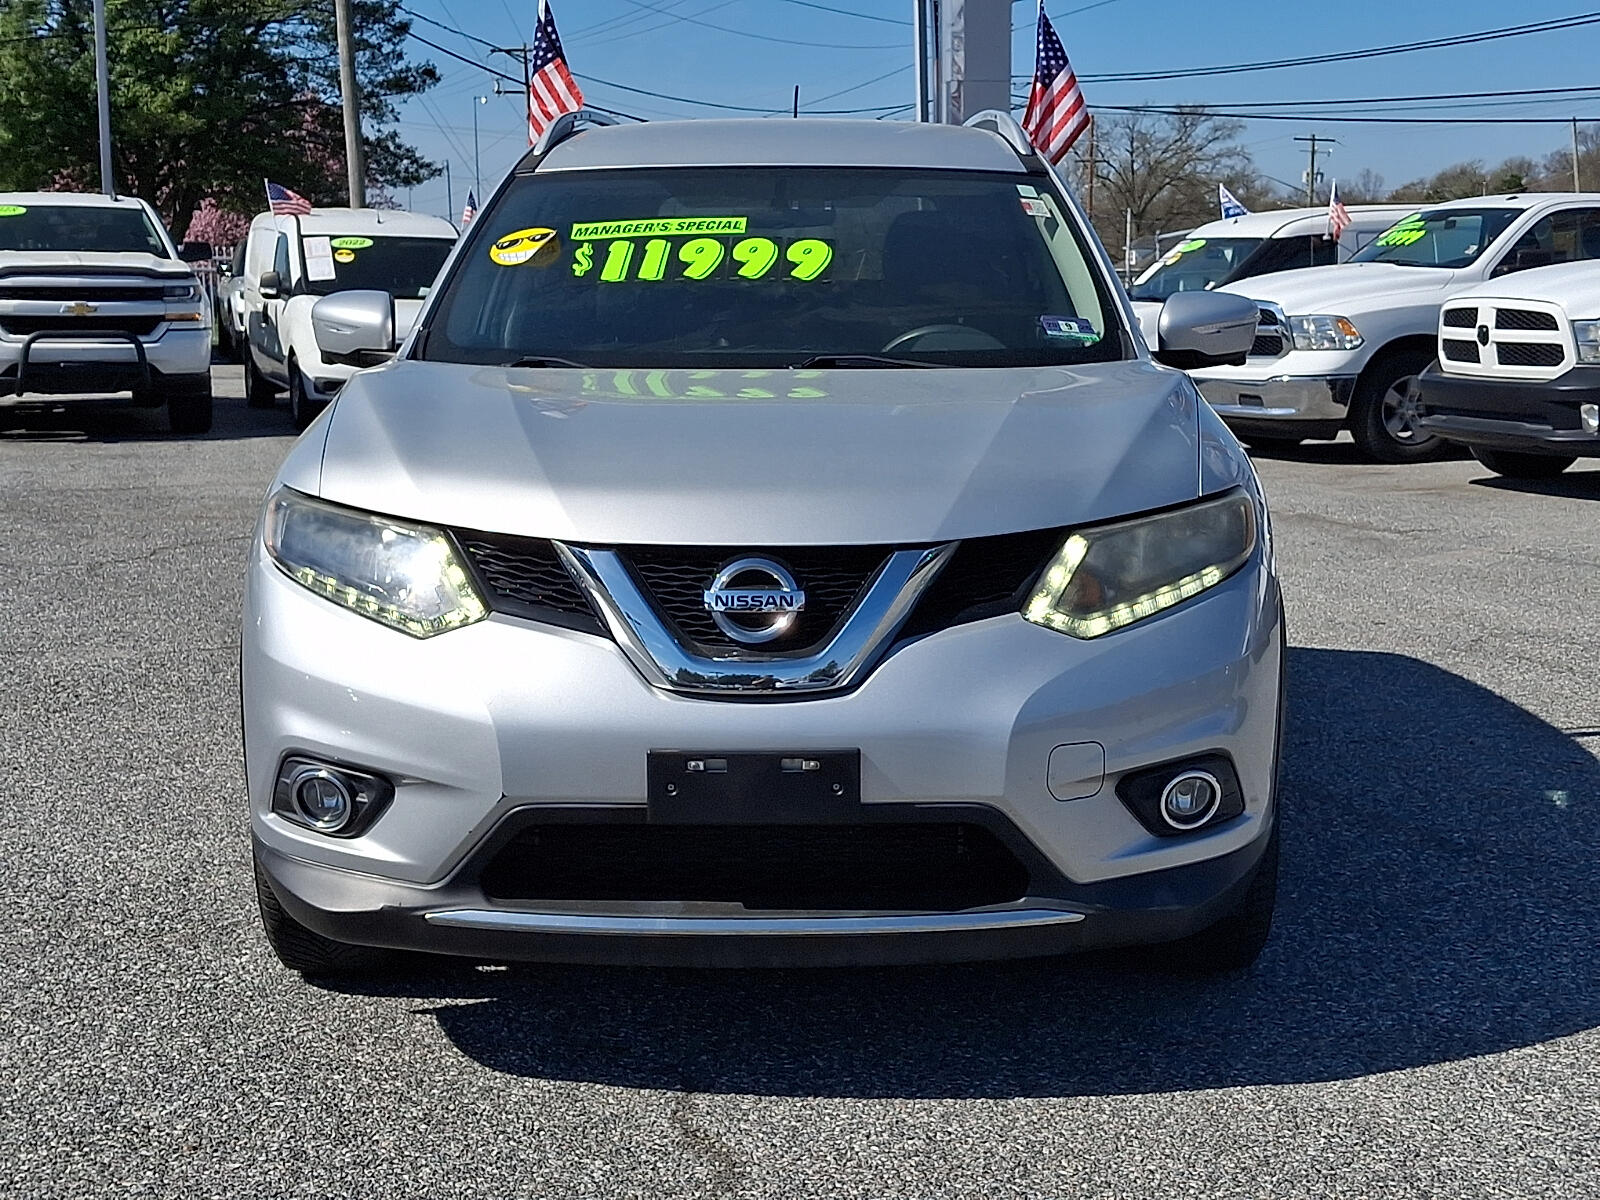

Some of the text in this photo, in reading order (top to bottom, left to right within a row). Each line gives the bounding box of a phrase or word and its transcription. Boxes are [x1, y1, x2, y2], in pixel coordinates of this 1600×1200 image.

[574, 219, 744, 238] MANAGER'S SPECIAL
[1065, 322, 1073, 330] 9
[714, 594, 794, 608] NISSAN
